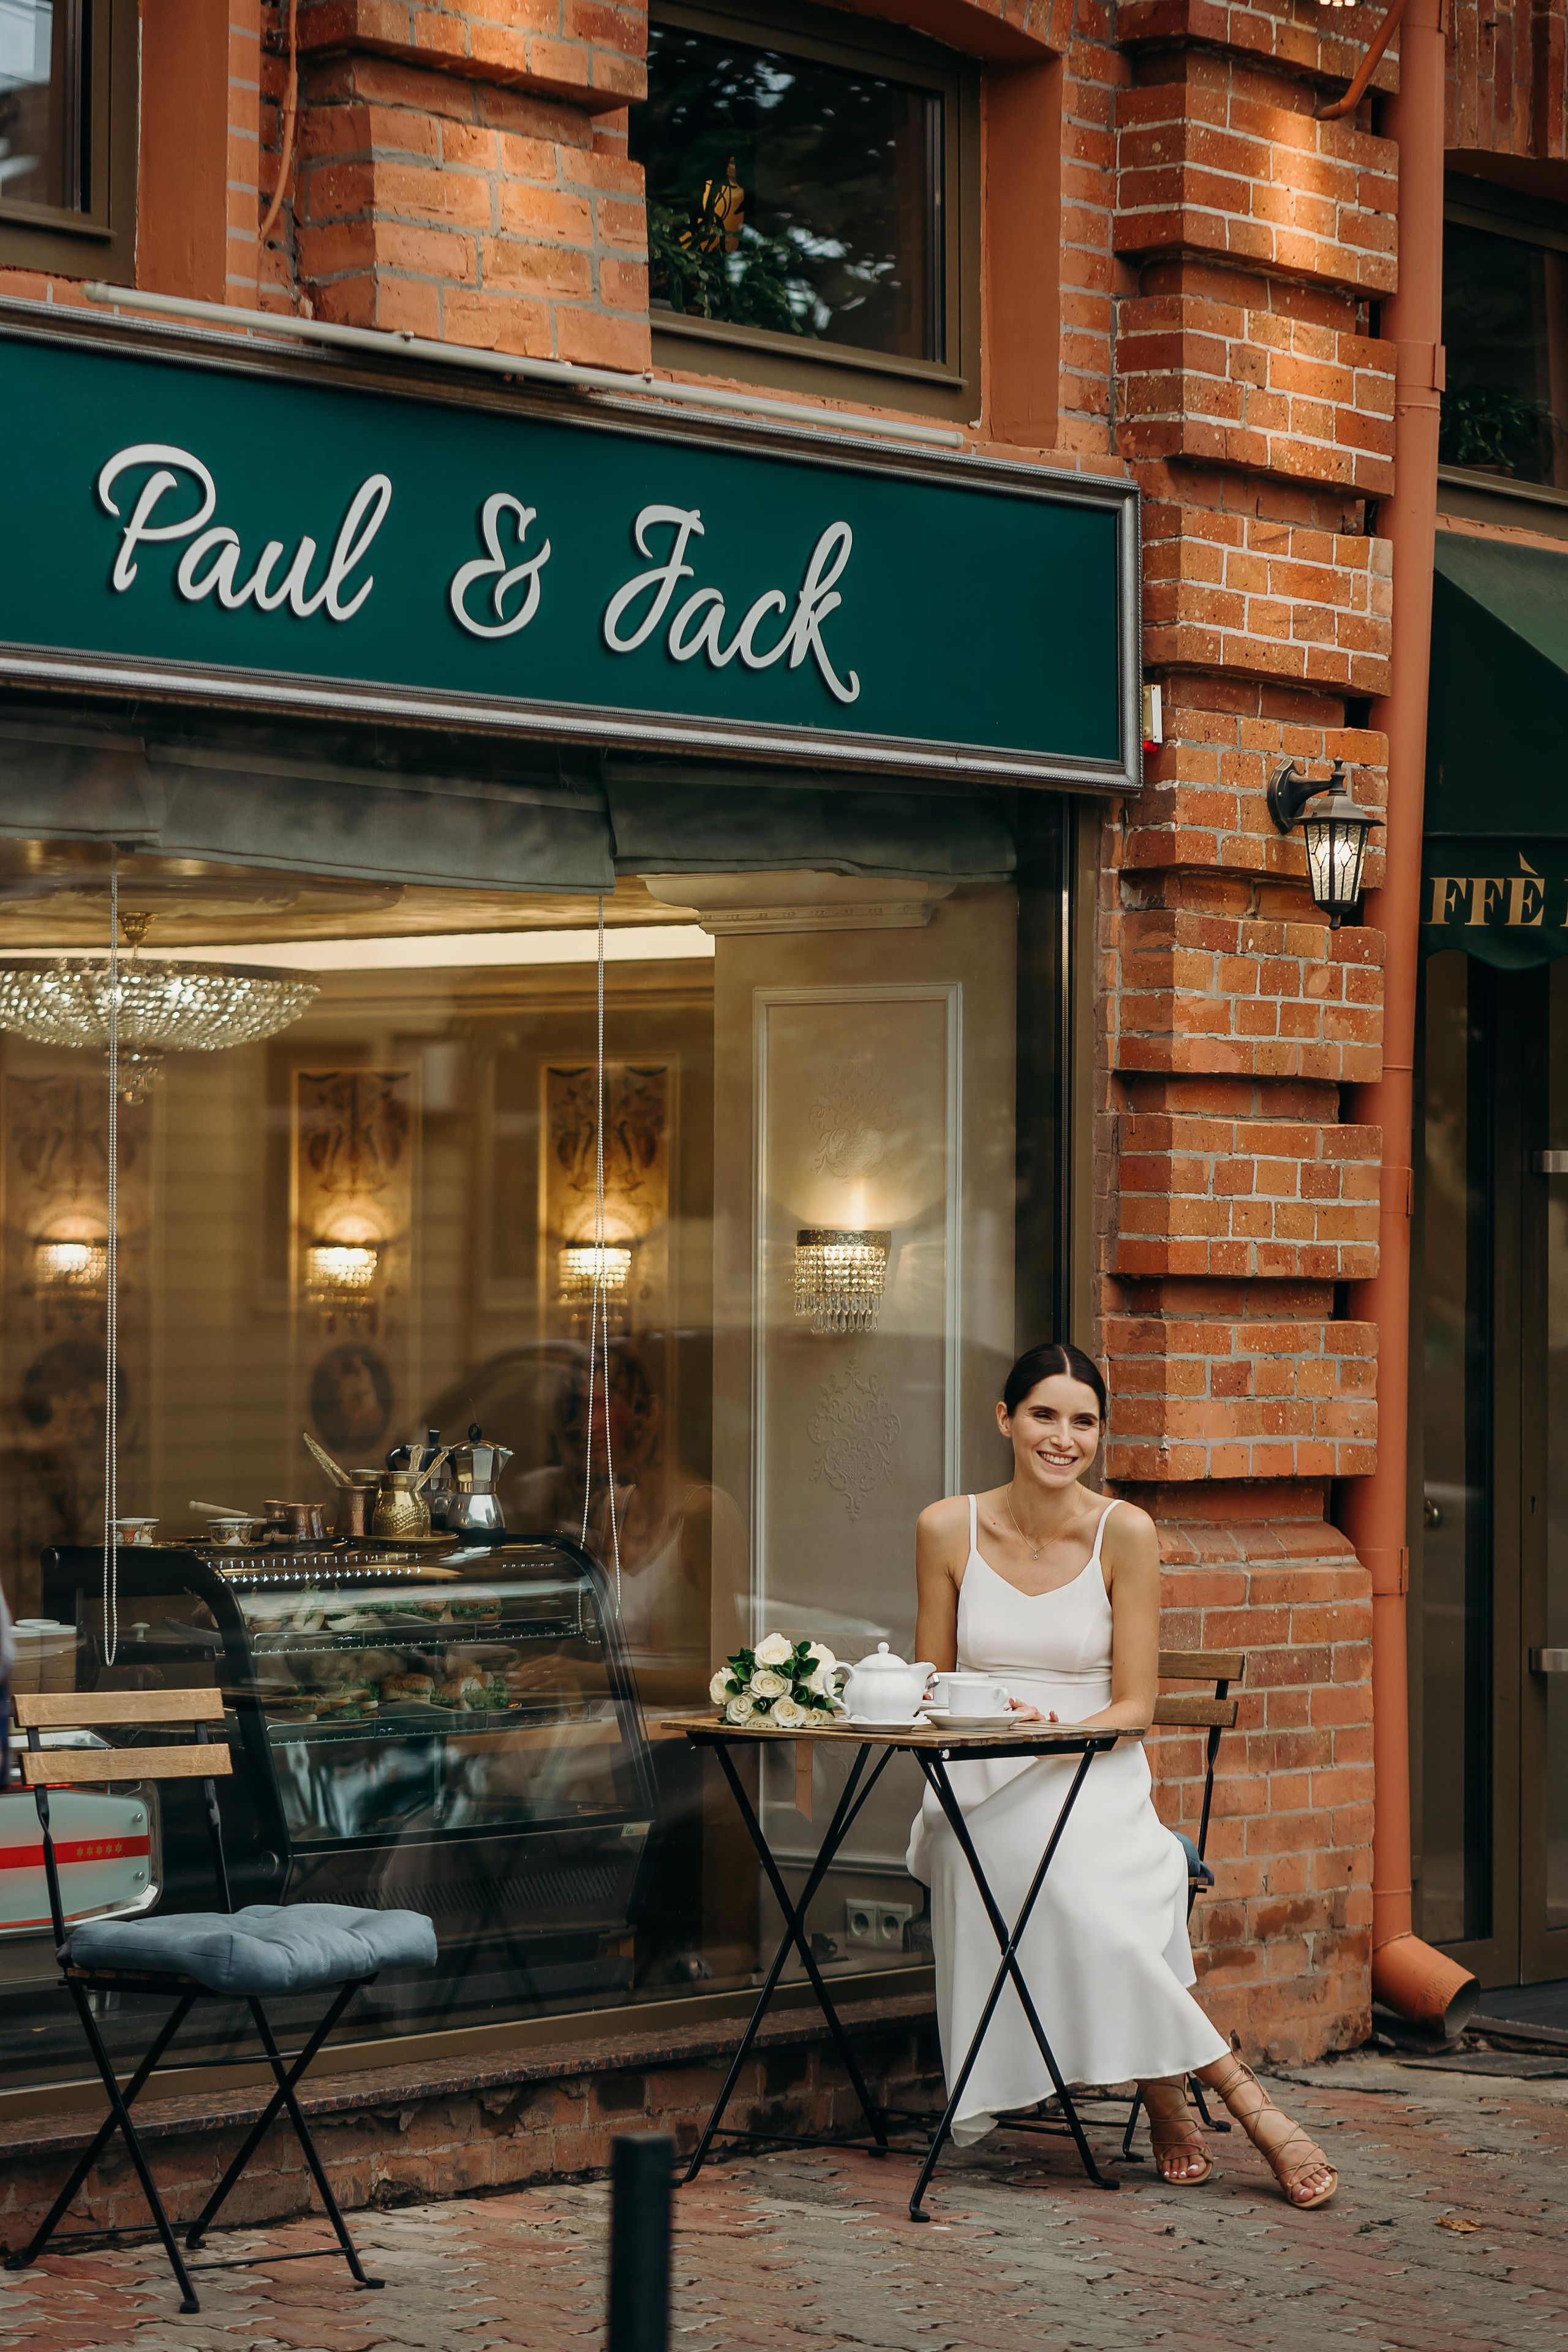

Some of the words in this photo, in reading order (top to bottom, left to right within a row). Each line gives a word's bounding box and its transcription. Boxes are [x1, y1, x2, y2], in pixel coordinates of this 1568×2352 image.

[99, 443, 392, 621] Paul
[450, 492, 551, 638] &
[603, 505, 860, 703] Jack
